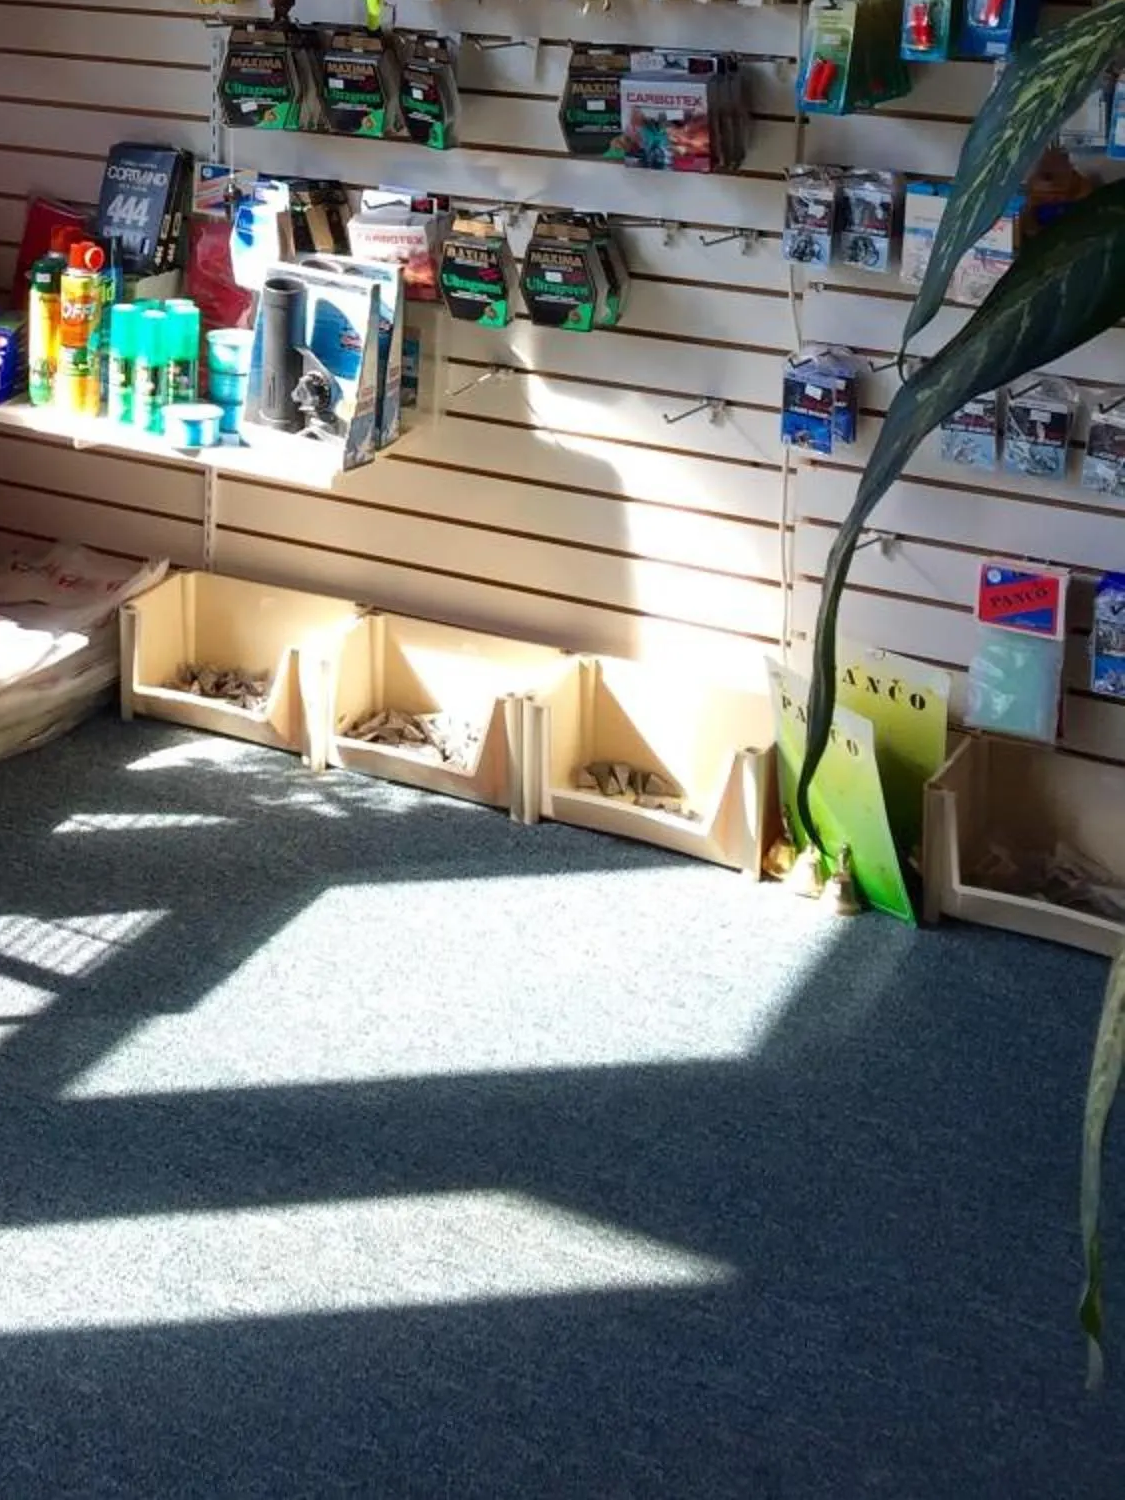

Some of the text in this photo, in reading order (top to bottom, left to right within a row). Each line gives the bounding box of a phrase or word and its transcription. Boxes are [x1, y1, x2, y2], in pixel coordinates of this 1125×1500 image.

[230, 56, 282, 70] MAXIMA
[626, 91, 703, 107] CARBOTEX
[106, 194, 150, 227] 444
[529, 252, 583, 268] MAXIMA
